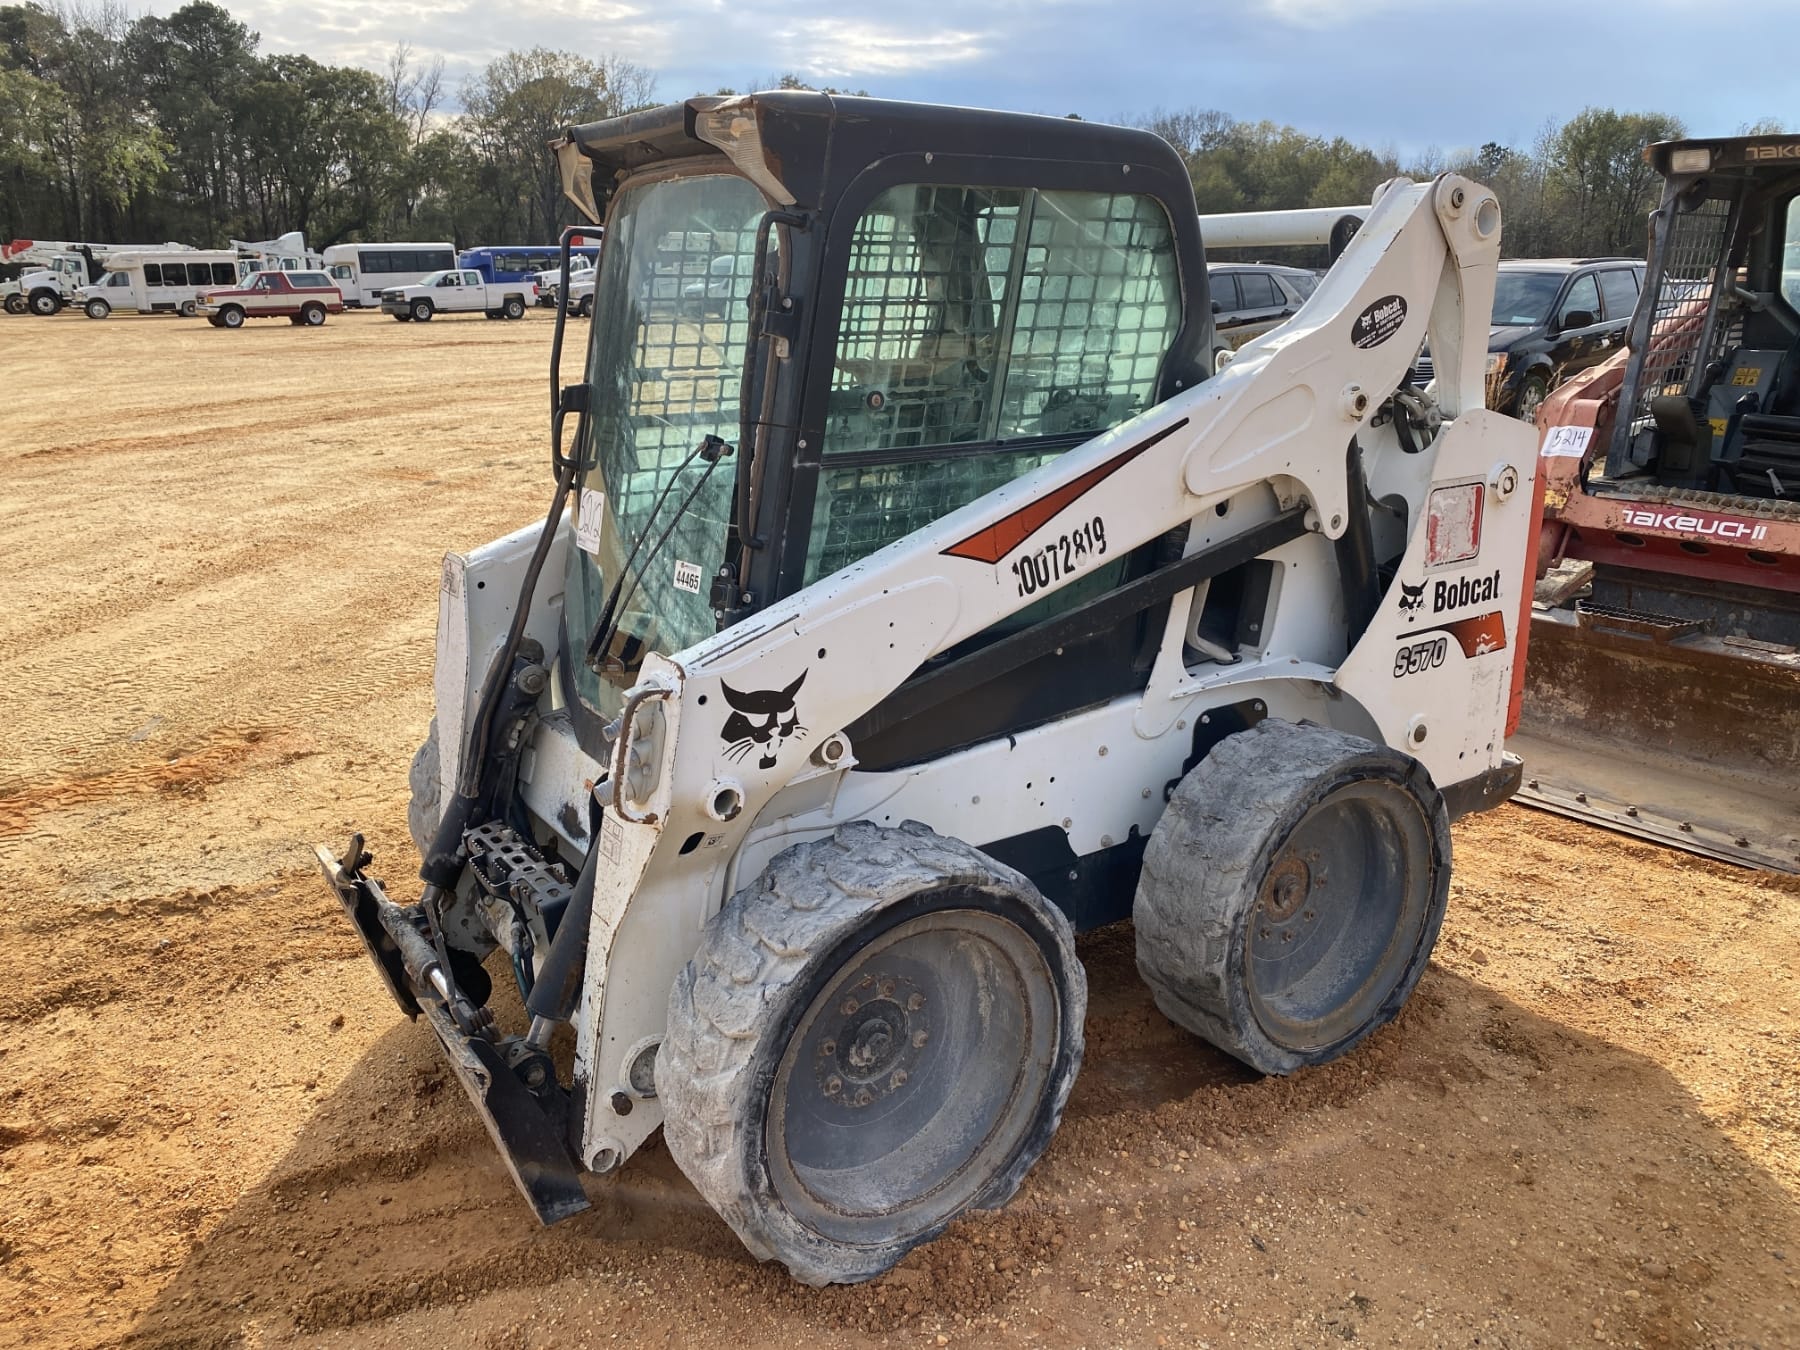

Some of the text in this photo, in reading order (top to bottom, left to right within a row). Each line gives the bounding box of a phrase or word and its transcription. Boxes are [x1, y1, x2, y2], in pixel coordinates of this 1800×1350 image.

[1374, 298, 1400, 323] Bobcat
[1551, 428, 1586, 448] 5214
[1012, 516, 1107, 597] 10072819
[676, 570, 699, 590] 44465
[1433, 569, 1500, 613] Bobcat
[1393, 637, 1447, 678] S570
